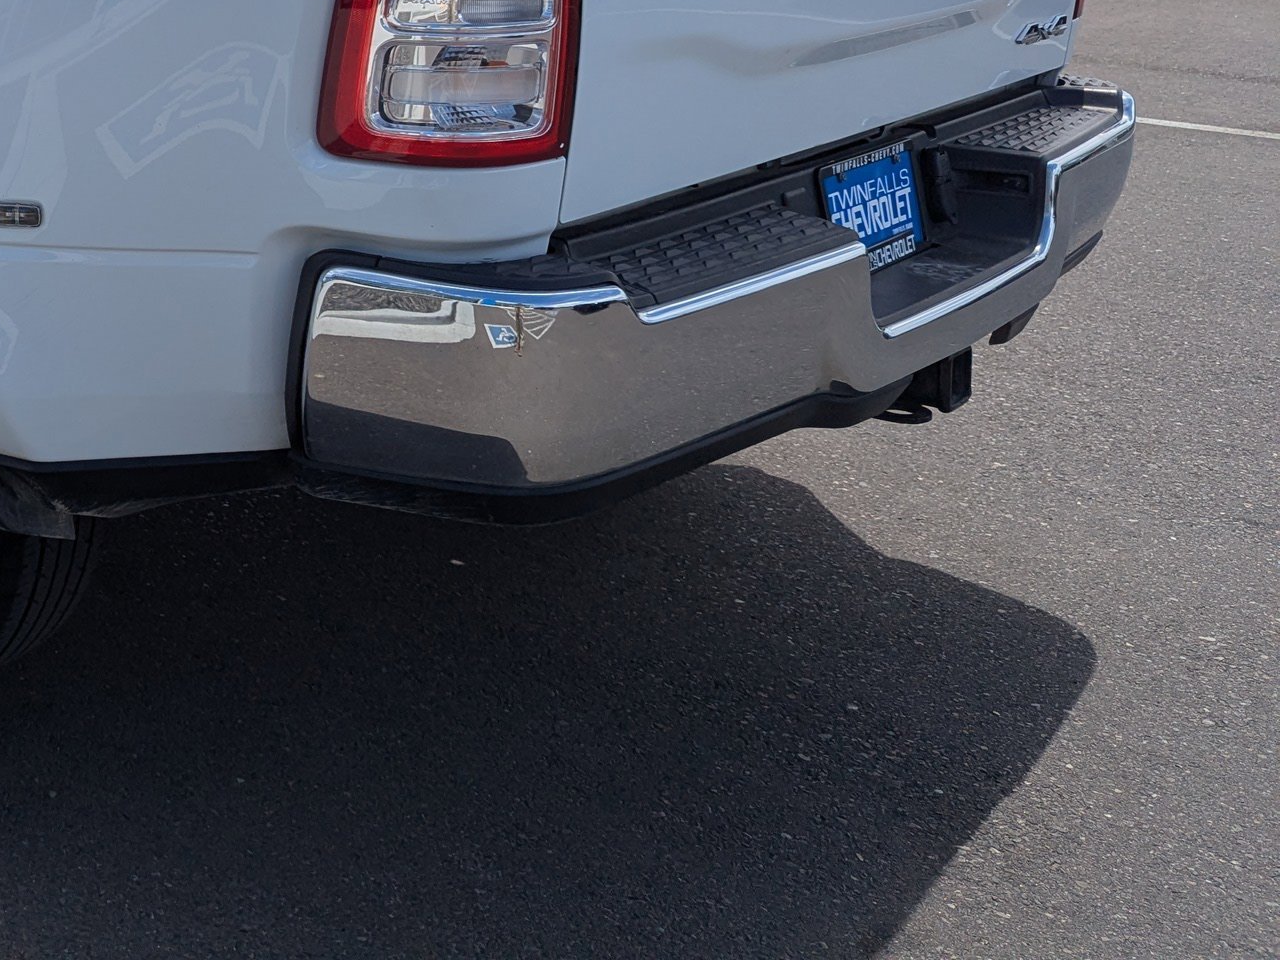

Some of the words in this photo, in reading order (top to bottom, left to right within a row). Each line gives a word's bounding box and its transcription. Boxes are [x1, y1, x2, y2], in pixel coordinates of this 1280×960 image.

[832, 143, 904, 175] TWINFALLS-CHEVY.COM
[828, 168, 910, 213] TWINFALLS
[877, 234, 916, 267] CHEVROLET
